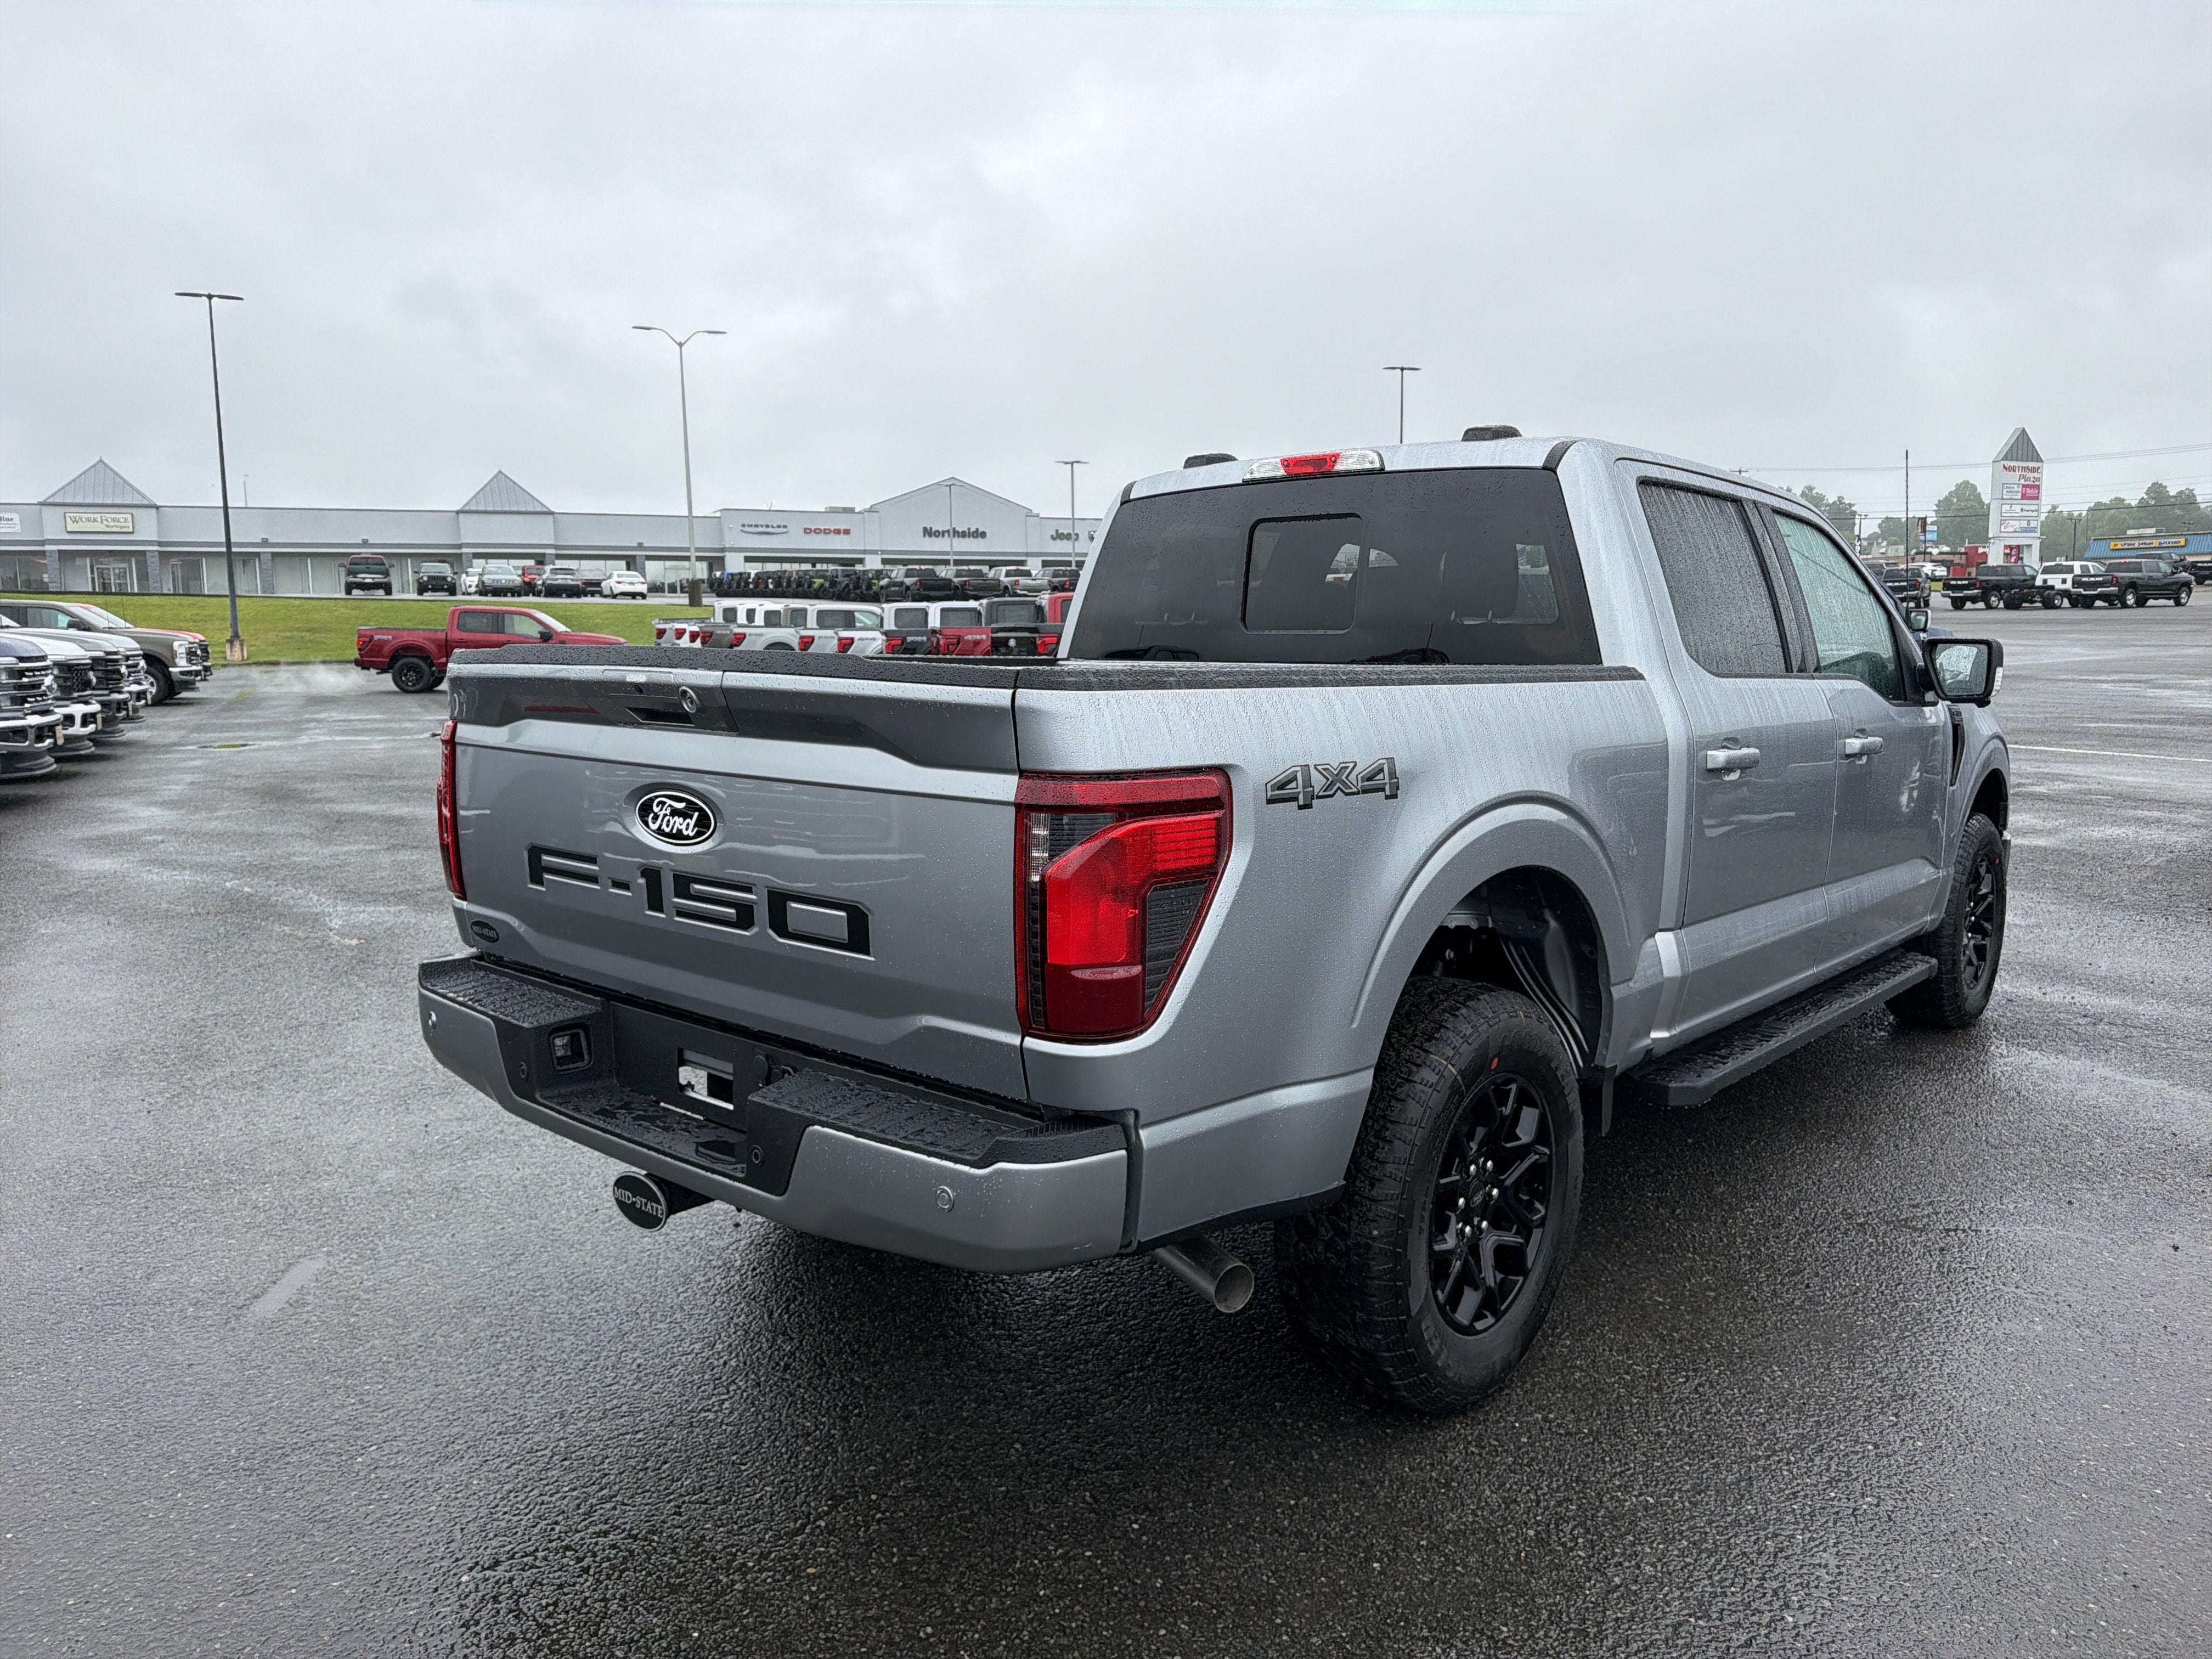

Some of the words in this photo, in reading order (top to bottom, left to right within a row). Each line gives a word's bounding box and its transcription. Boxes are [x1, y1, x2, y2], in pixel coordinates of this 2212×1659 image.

[2003, 464, 2040, 473] NORTHSIDE
[2018, 473, 2040, 483] Plaza
[68, 515, 98, 523] WORK
[99, 515, 129, 523] FORCE
[923, 527, 987, 539] Northside
[648, 797, 699, 837] Ford
[526, 842, 876, 961] F-150
